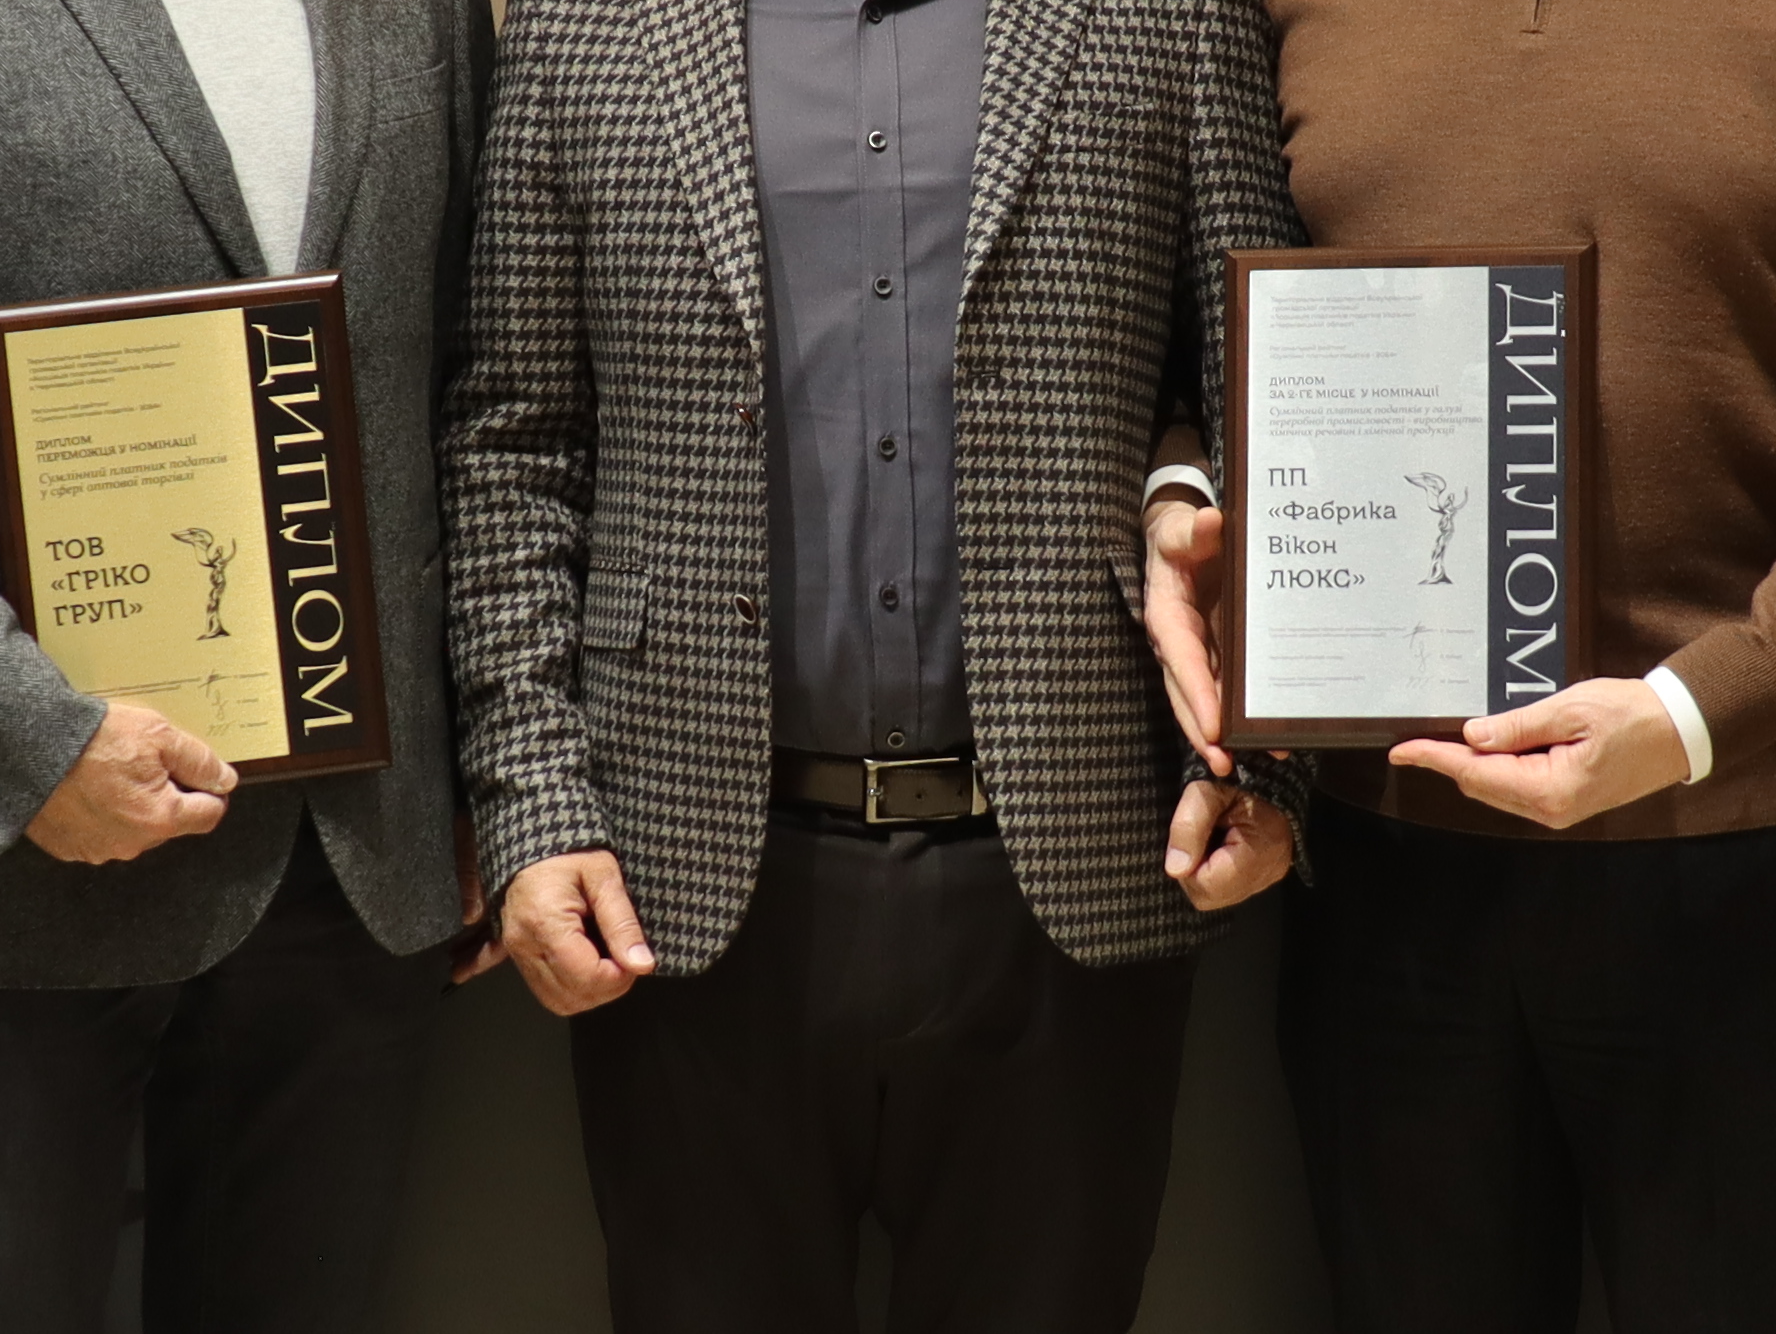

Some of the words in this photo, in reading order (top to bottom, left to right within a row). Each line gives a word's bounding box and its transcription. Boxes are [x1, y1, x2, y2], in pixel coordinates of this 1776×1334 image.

[1269, 376, 1324, 386] ДИПЛОМ
[1269, 389, 1284, 399] ЗА
[1316, 388, 1355, 398] МІСЦЕ
[1360, 388, 1368, 398] У
[1371, 385, 1438, 397] НОМІНАЦІЇ
[35, 435, 91, 450] ДИПЛОМ
[37, 446, 116, 462] ПЕРЕМОЖЦЯ
[118, 444, 126, 453] У
[129, 434, 196, 451] НОМІНАЦІЇ
[38, 467, 106, 486] Сумлінний
[109, 462, 165, 475] платник
[169, 452, 227, 468] податків
[1268, 467, 1306, 486] ПП
[40, 490, 47, 500] у
[50, 485, 83, 498] сфері
[86, 476, 138, 491] оптової
[141, 471, 194, 486] торгівлі
[1495, 283, 1558, 701] ДИПЛОМ
[1269, 500, 1396, 524] «Фабрика
[251, 324, 353, 736] ДИПЛОМ
[45, 536, 103, 560] ТОВ
[1268, 535, 1336, 554] Вікон
[51, 563, 150, 591] «ГРІКО
[1267, 568, 1364, 589] ЛЮКС»
[53, 599, 142, 626] ГРУП»
